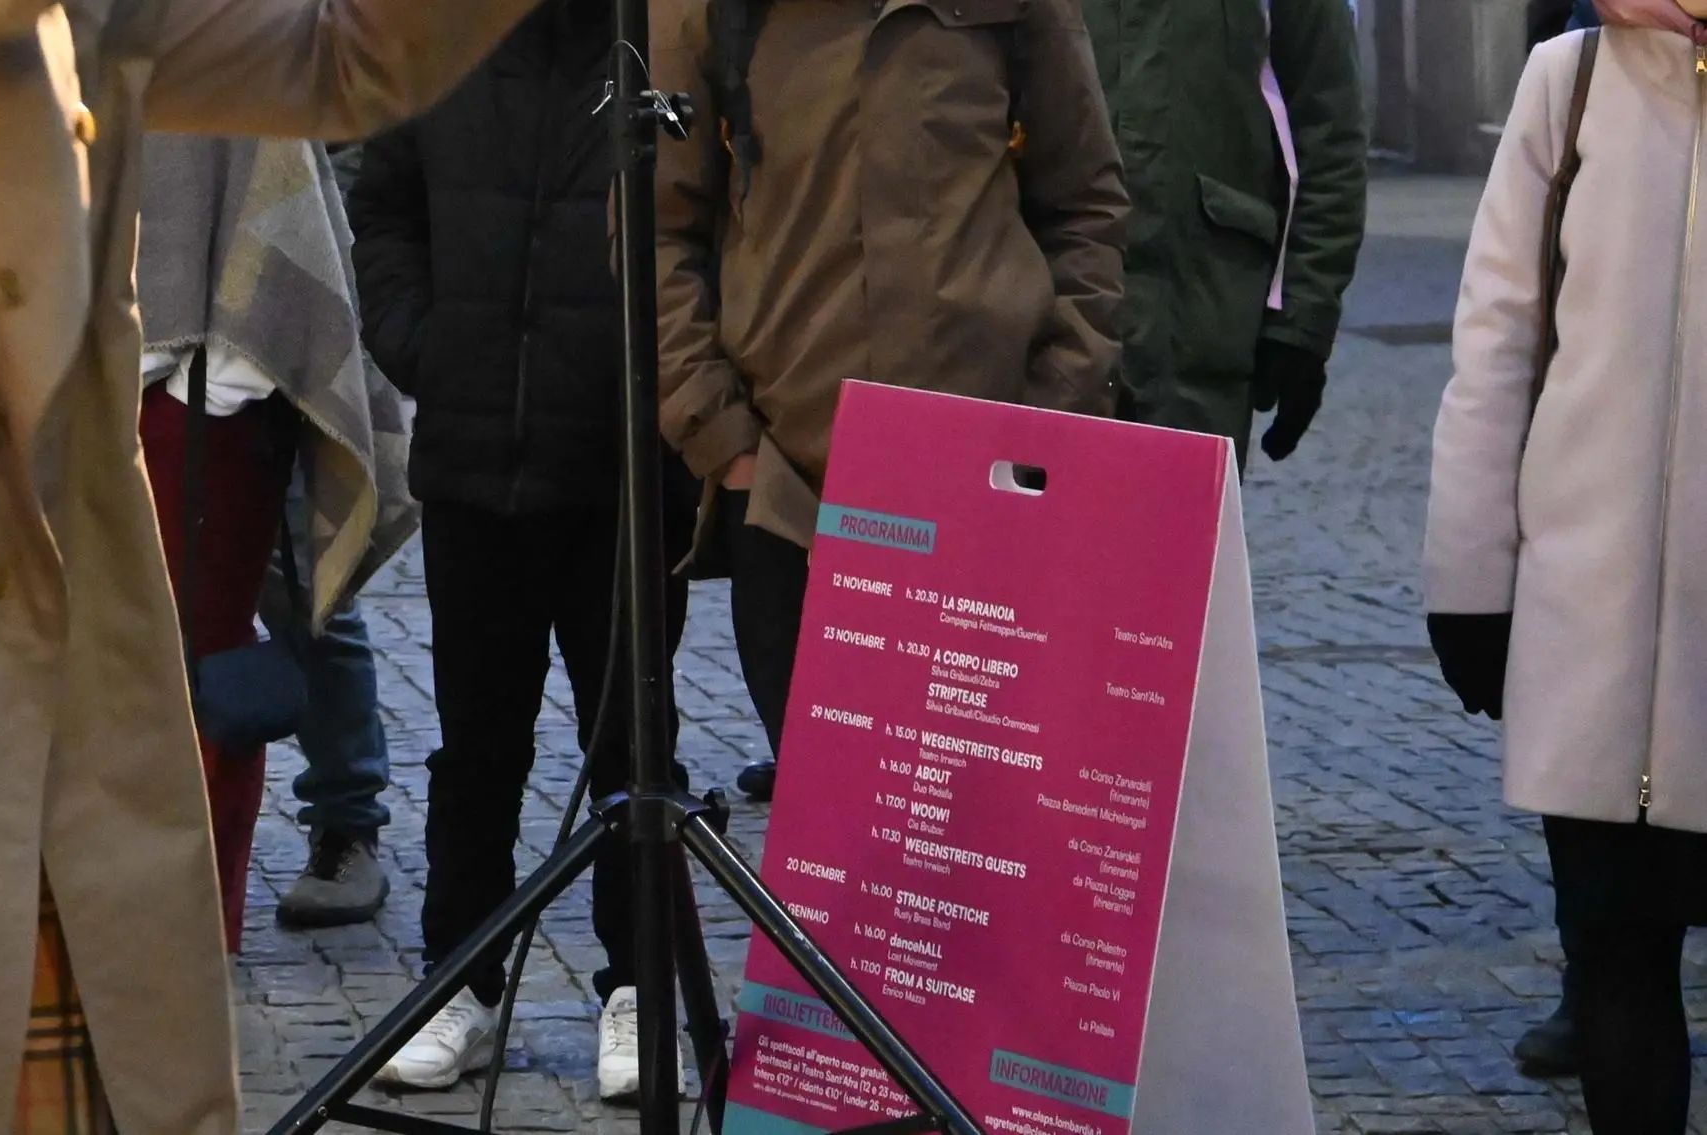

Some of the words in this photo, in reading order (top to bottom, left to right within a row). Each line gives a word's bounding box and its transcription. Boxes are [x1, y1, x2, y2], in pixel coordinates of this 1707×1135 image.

[839, 514, 930, 548] PROGRAMMA
[832, 573, 842, 586] 12
[842, 575, 893, 596] NOVEMBRE
[905, 587, 914, 599] h.
[914, 589, 938, 604] 20.30
[941, 594, 955, 610] LA
[956, 598, 1016, 621] SPARANOIA
[938, 611, 978, 630] Compagnia
[823, 626, 835, 639] 23
[835, 628, 885, 649] NOVEMBRE
[1113, 627, 1138, 643] Teatro
[1139, 632, 1173, 649] Sant'Afra
[896, 640, 905, 652] h.
[906, 641, 930, 657] 20.30
[933, 648, 942, 662] A
[942, 650, 980, 670] CORPO
[980, 658, 1019, 678] LIBERO
[930, 665, 949, 678] Silvia
[925, 699, 943, 712] Silvia
[927, 682, 987, 707] STRIPTEASE
[1105, 682, 1129, 698] Teatro
[1130, 687, 1165, 705] Sant'Afra
[810, 704, 822, 718] 29
[823, 707, 873, 729] NOVEMBRE
[884, 723, 893, 736] h.
[894, 725, 917, 741] 15.00
[920, 731, 999, 761] WEGENSTREITS
[1000, 748, 1043, 771] GUESTS
[918, 747, 939, 762] Teatro
[879, 758, 888, 769] h.
[889, 760, 911, 775] 16.00
[915, 764, 951, 785] ABOUT
[1078, 767, 1089, 779] da
[1090, 768, 1114, 784] Corso
[912, 782, 927, 794] Duo
[875, 792, 883, 804] h.
[909, 801, 950, 822] WOOW!
[1037, 793, 1061, 809] Piazza
[871, 825, 879, 837] h.
[903, 836, 983, 868] WEGENSTREITS
[984, 855, 1026, 878] GUESTS
[1068, 837, 1078, 849] da
[1078, 839, 1102, 855] Corso
[786, 856, 799, 871] 20
[799, 860, 846, 883] DICEMBRE
[1072, 874, 1083, 886] da
[1084, 876, 1108, 892] Piazza
[1109, 882, 1135, 902] Loggia
[787, 902, 829, 924] GENNAIO
[860, 880, 868, 892] h.
[870, 883, 892, 898] 16.00
[895, 890, 935, 912] STRADE
[937, 900, 989, 925] POETICHE
[893, 907, 912, 923] Rusty
[932, 917, 951, 931] Band
[854, 922, 862, 934] h.
[863, 925, 886, 940] 16.00
[889, 932, 943, 958] dancehALL
[1060, 930, 1071, 944] da
[1071, 932, 1096, 950] Corso
[850, 957, 858, 969] h.
[884, 966, 914, 987] FROM
[915, 975, 924, 989] A
[925, 977, 975, 1003] SUITCASE
[882, 984, 903, 999] Enrico
[1063, 976, 1088, 993] Piazza
[1088, 983, 1111, 999] Paolo
[1111, 989, 1120, 1001] VI
[763, 992, 850, 1033] BIGLIETTERI
[758, 1034, 769, 1047] Gli
[770, 1038, 805, 1059] spettacoli
[805, 1048, 840, 1069] all'aperto
[841, 1062, 859, 1073] sono
[755, 1050, 792, 1072] Spettacoli
[800, 1062, 824, 1079] Teatro
[825, 1070, 858, 1089] Sant'Afra
[859, 1079, 870, 1094] (12
[877, 1086, 888, 1098] 23
[995, 1057, 1108, 1106] INFORMAZIONE
[753, 1065, 775, 1081] Intero
[798, 1079, 823, 1095] ridotto
[842, 1091, 868, 1110] (under
[1010, 1103, 1102, 1135] www.claps.lombardiait
